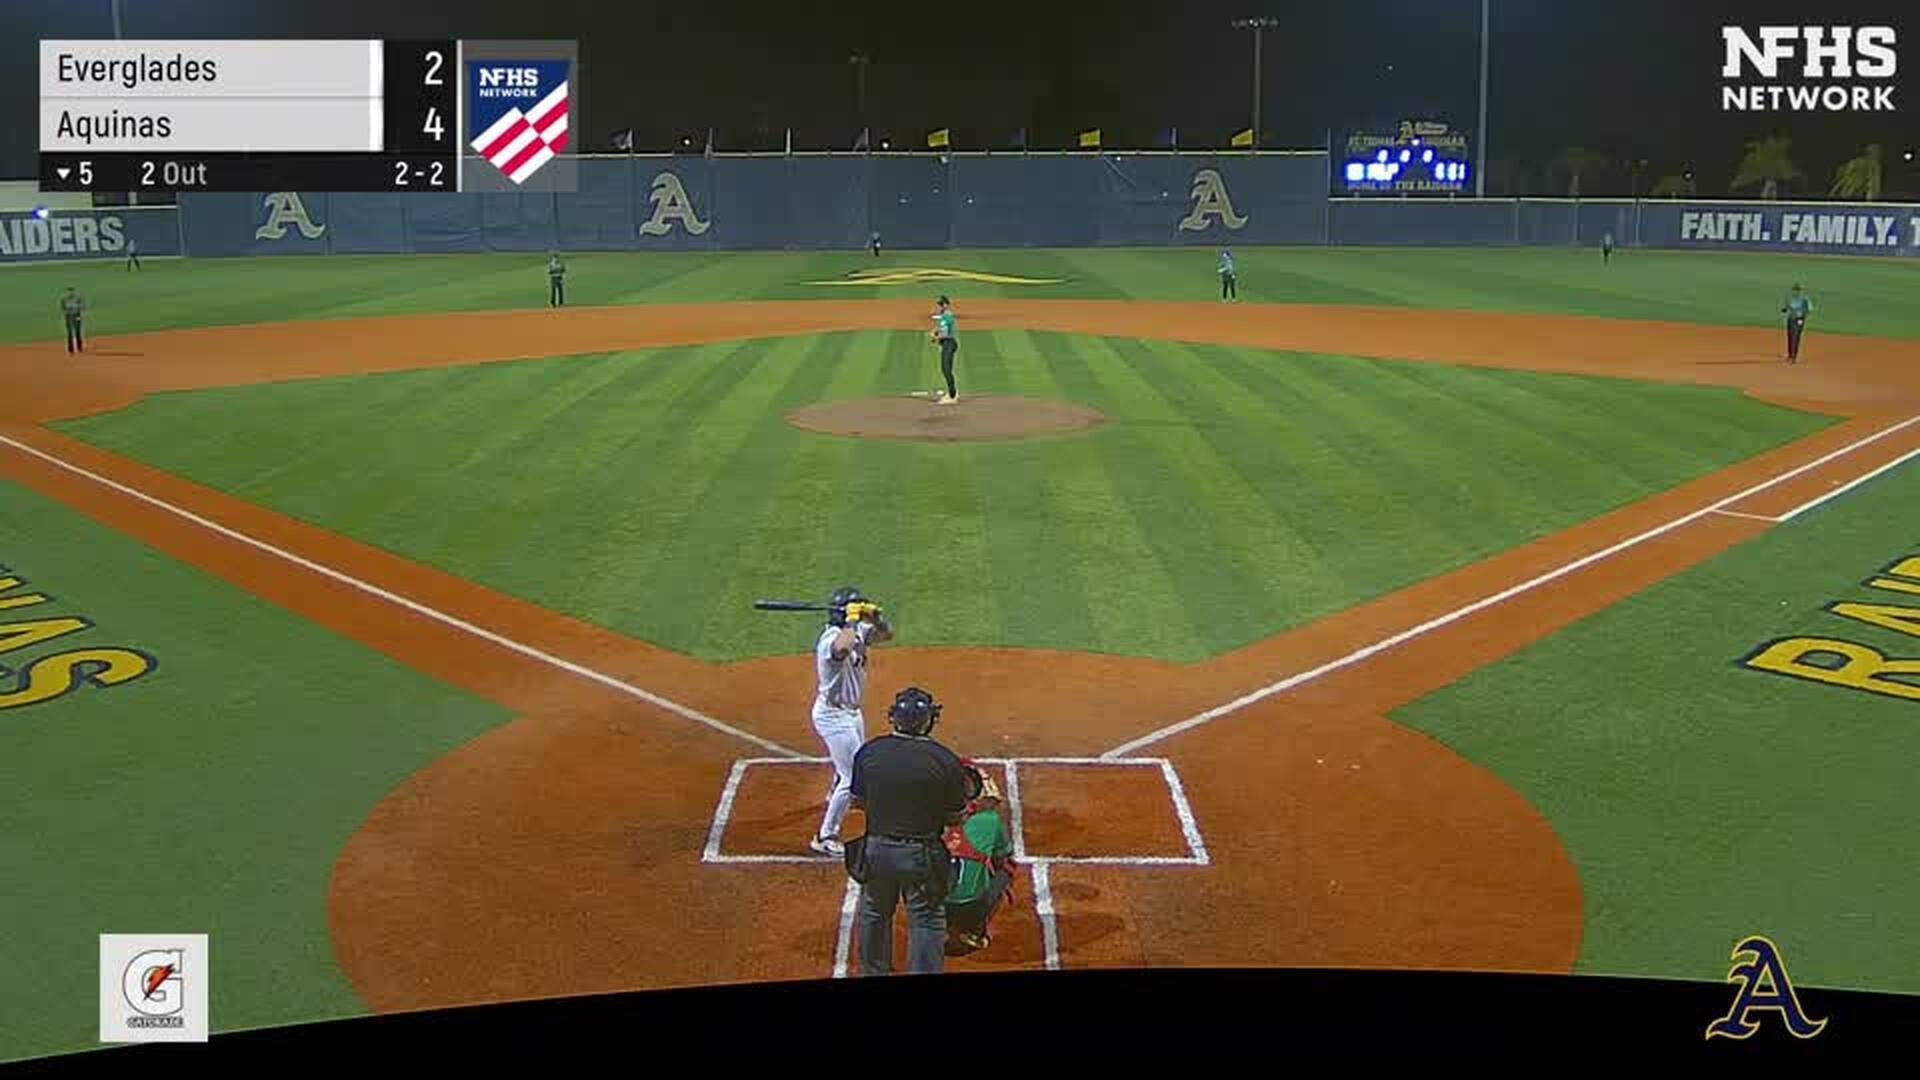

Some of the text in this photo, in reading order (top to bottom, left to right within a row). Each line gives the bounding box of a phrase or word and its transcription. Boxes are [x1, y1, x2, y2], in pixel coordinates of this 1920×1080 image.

[256, 191, 325, 240] A
[640, 172, 710, 235] A
[1179, 169, 1248, 231] A
[1681, 212, 1771, 241] FAITH.
[1781, 214, 1898, 245] FAMILY.
